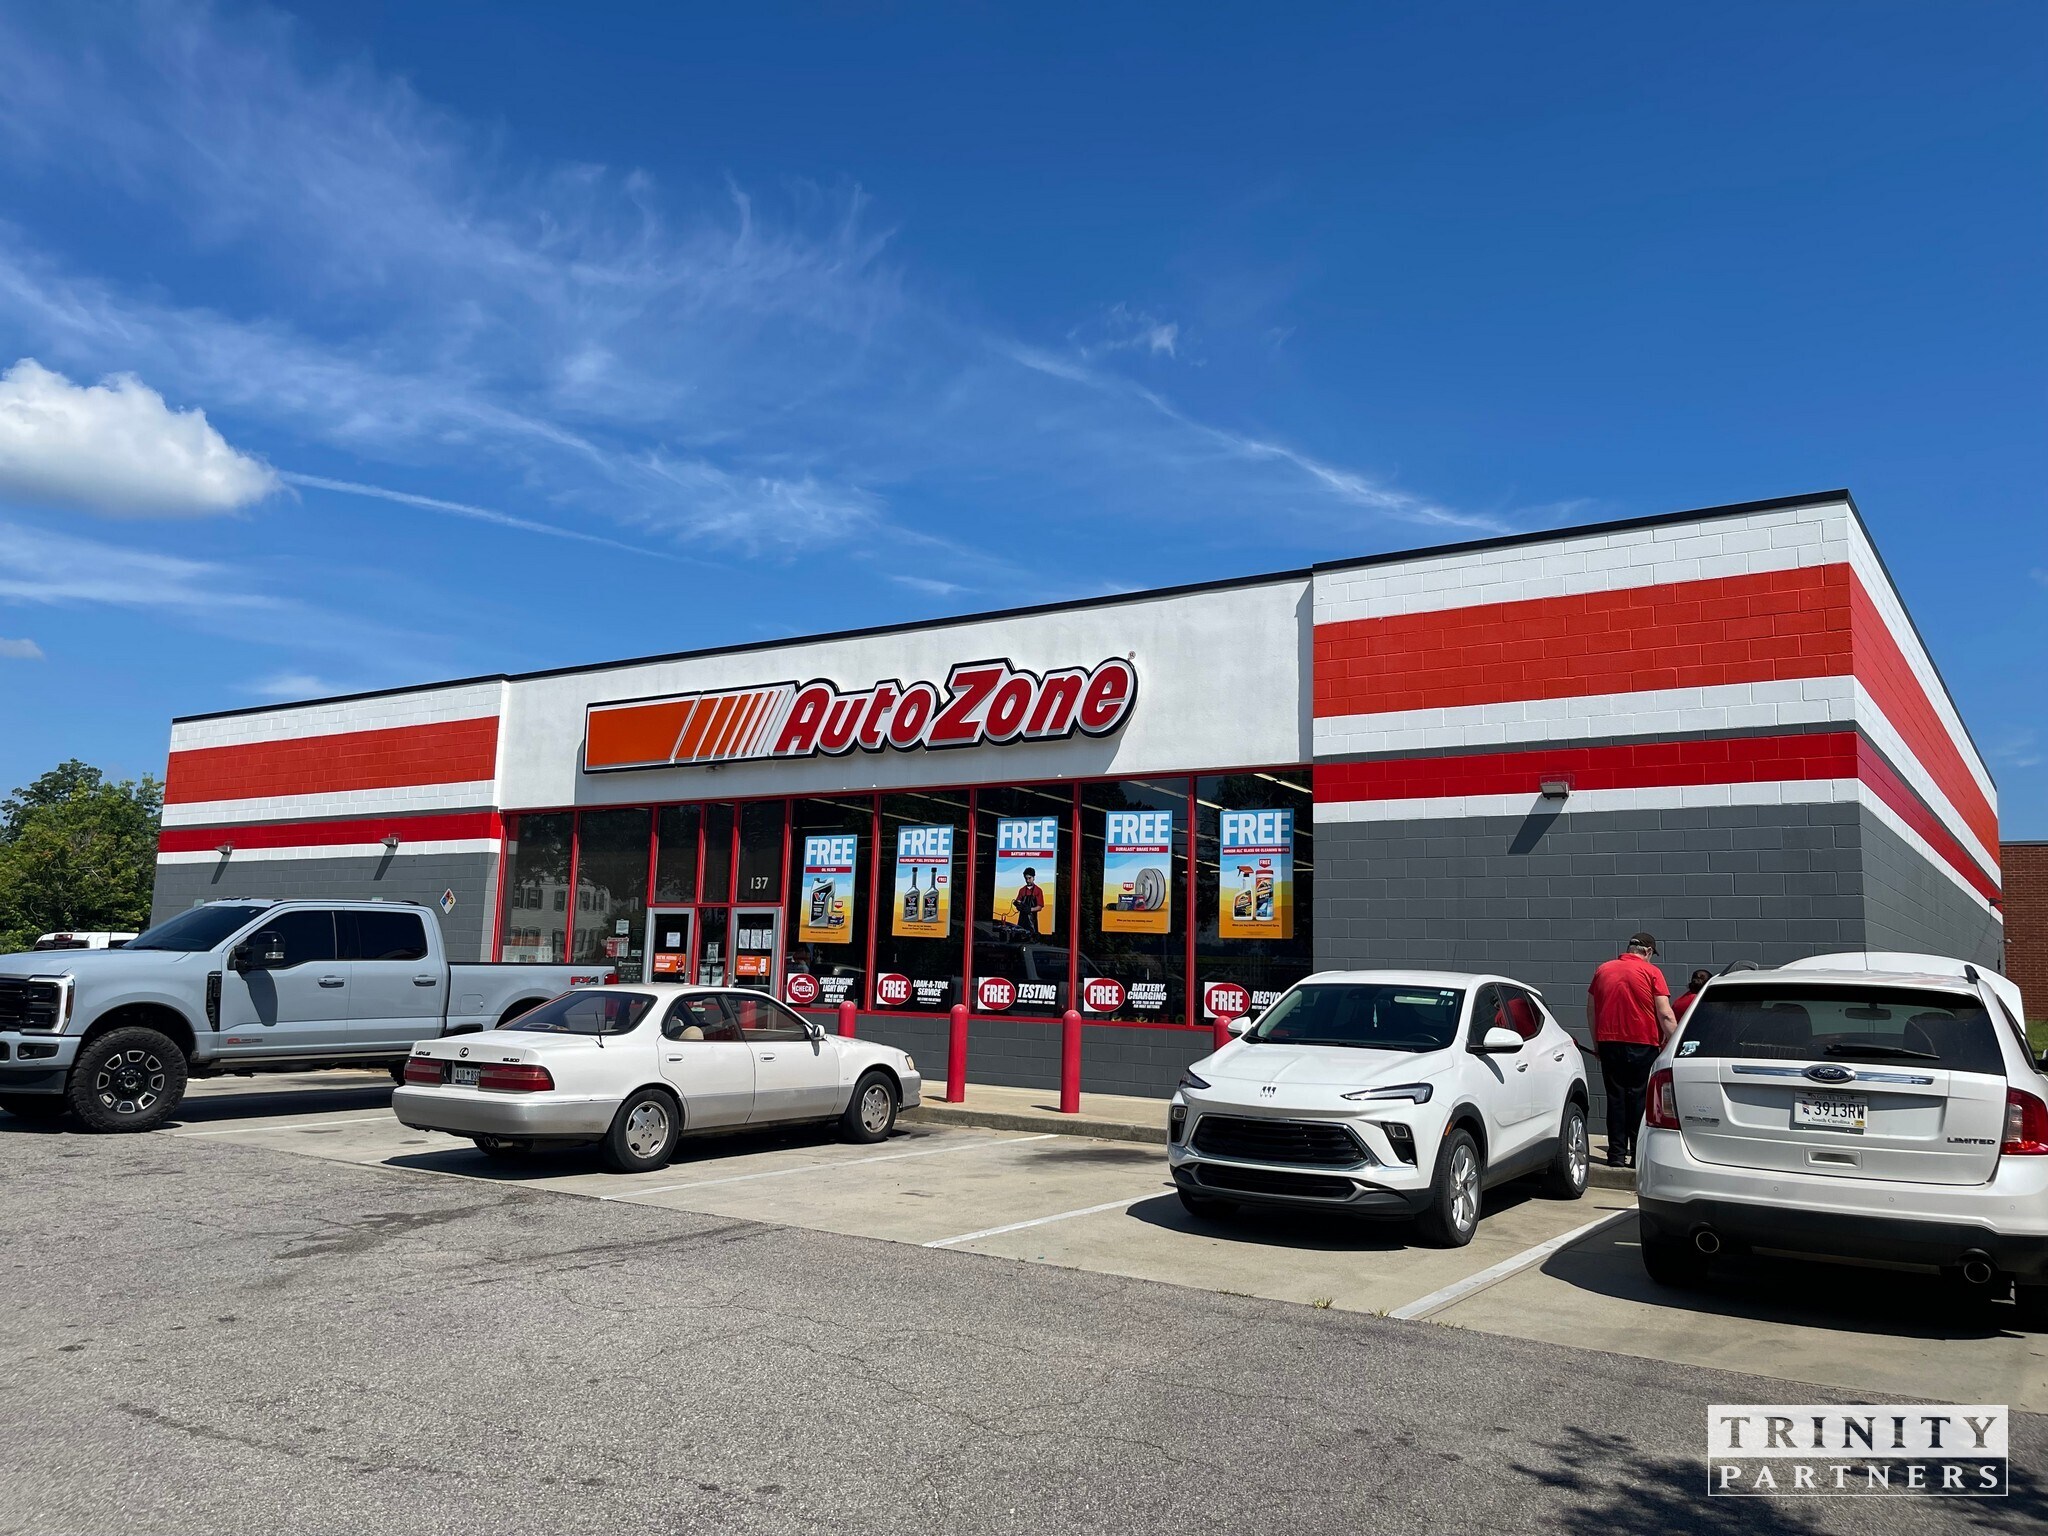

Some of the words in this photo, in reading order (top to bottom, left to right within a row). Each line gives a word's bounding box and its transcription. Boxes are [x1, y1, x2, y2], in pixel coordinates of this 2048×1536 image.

[773, 665, 1129, 753] AutoZone
[1000, 820, 1054, 849] FREE
[1107, 813, 1169, 844] FREE
[1223, 812, 1290, 845] FREE
[899, 828, 950, 855] FREE
[805, 838, 854, 865] FREE
[750, 876, 769, 890] 137
[570, 976, 599, 985] FX4
[795, 985, 812, 993] CHECK
[820, 977, 836, 985] CHECK
[836, 977, 854, 986] ENGINE
[822, 984, 836, 993] LIGHT
[882, 979, 907, 999] FREE
[1131, 982, 1166, 993] BATTERY
[917, 987, 941, 997] SERVICE
[983, 983, 1010, 1004] FREE
[1017, 983, 1057, 1000] TESTING
[1090, 985, 1119, 1005] FREE
[1127, 991, 1167, 1001] CHARGING
[1211, 989, 1243, 1012] FREE
[1817, 1068, 1841, 1079] Ford
[1814, 1101, 1865, 1119] 3913RW
[1946, 1136, 1996, 1145] LIMITED
